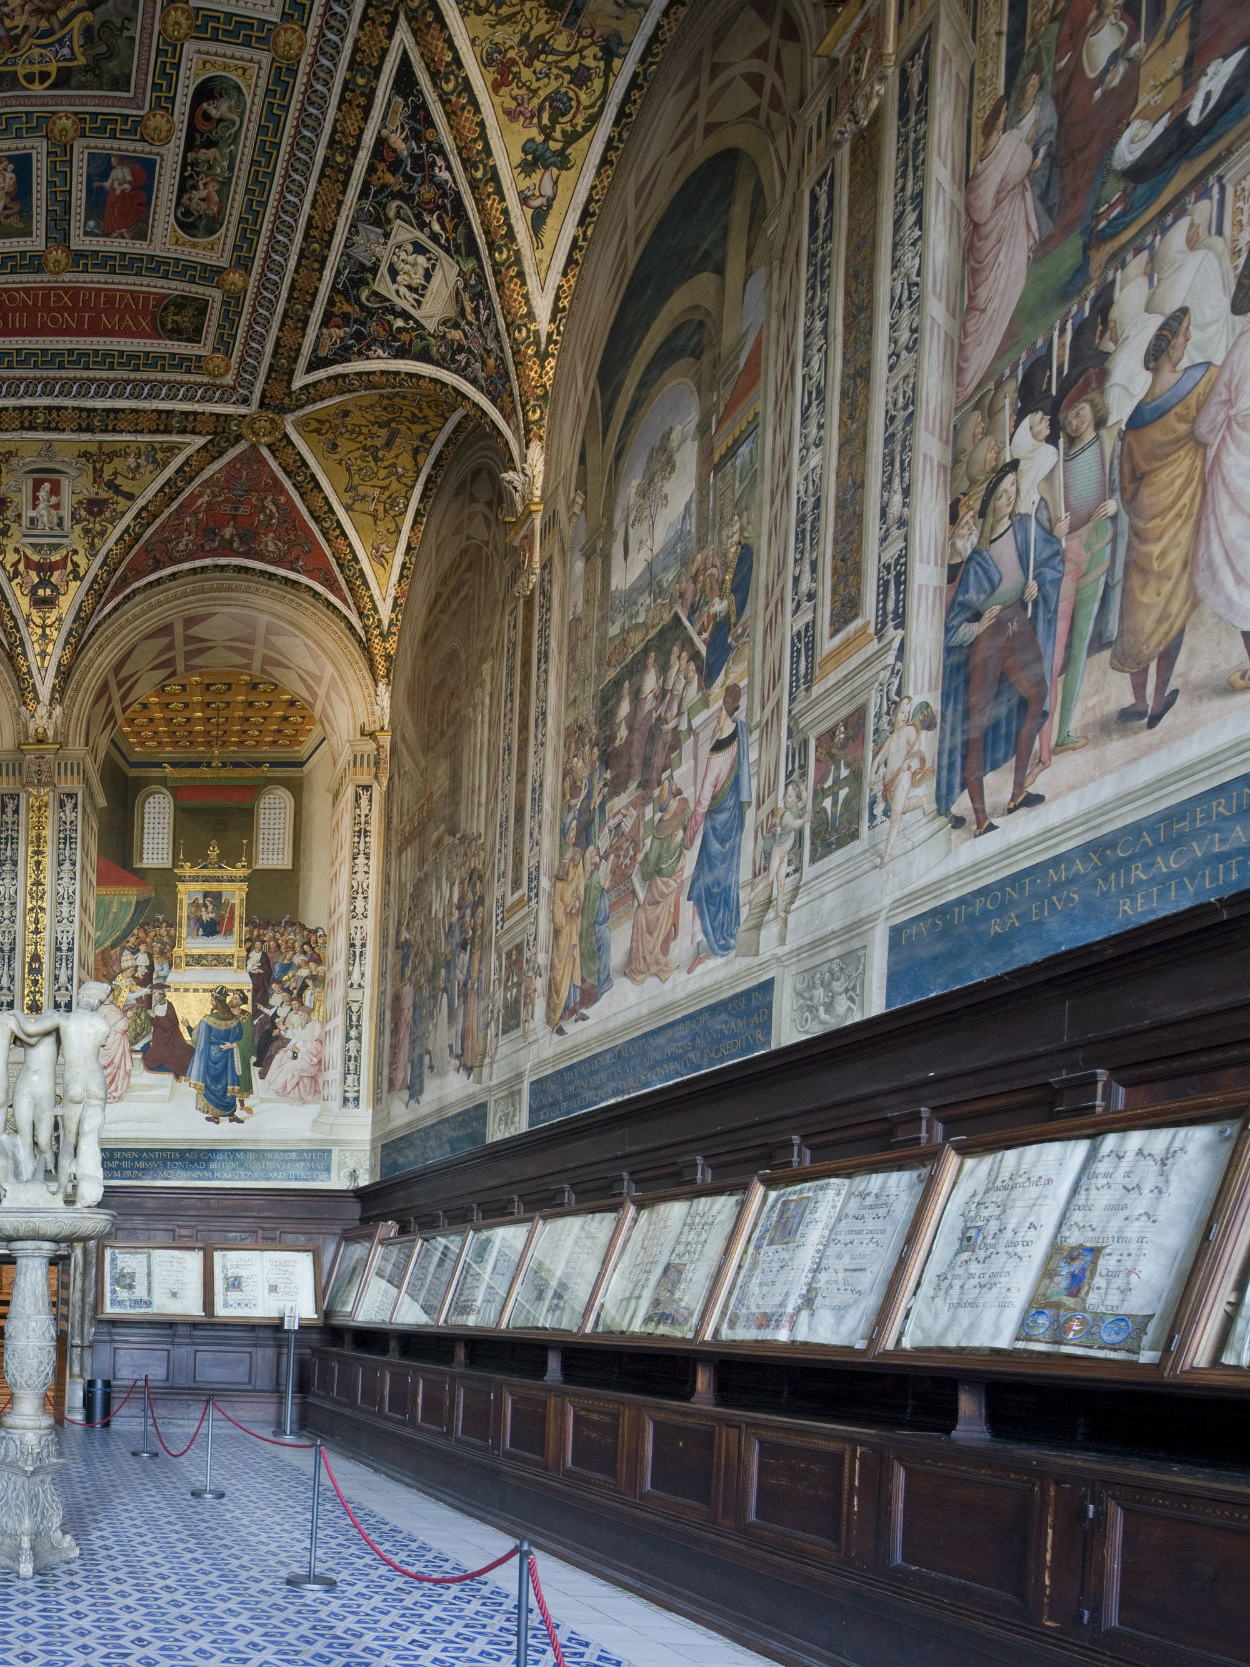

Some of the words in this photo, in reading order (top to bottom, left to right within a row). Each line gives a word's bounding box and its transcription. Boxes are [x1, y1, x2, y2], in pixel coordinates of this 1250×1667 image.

[8, 313, 28, 329] III
[37, 313, 95, 329] PONT
[101, 314, 151, 332] MAX
[990, 912, 1020, 937] RA
[1032, 887, 1079, 921] EIVS
[1096, 824, 1247, 897] MIRACVLA
[752, 991, 763, 1006] IN
[751, 1008, 768, 1026] AD
[134, 1161, 164, 1169] MISSVS
[192, 1161, 206, 1169] AD
